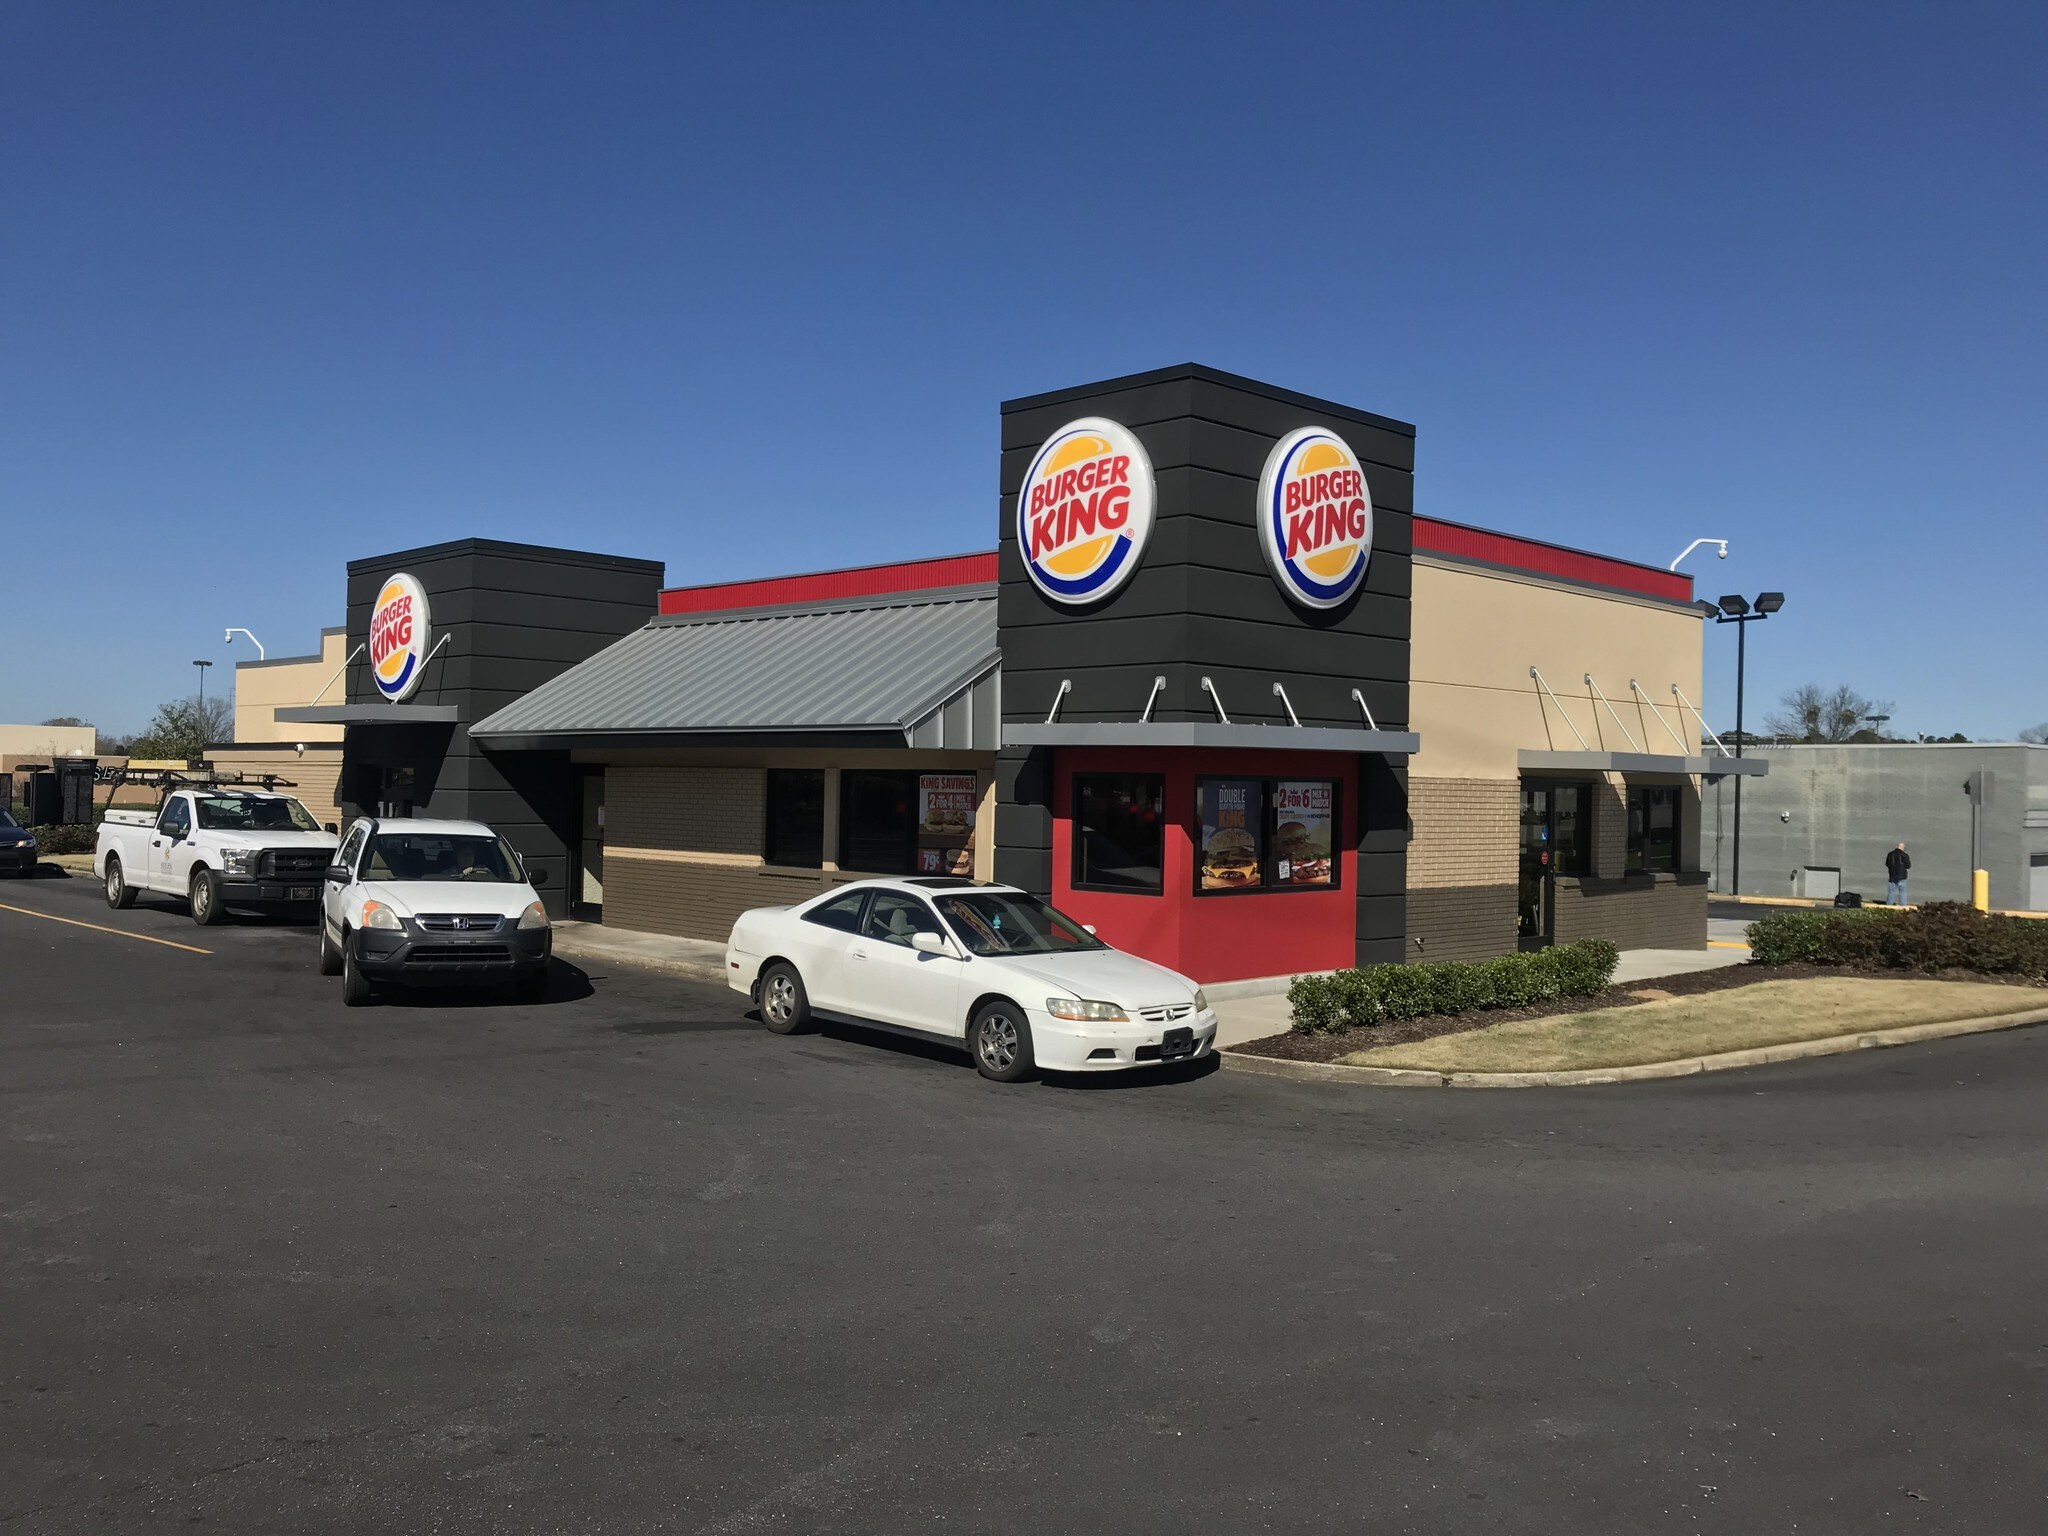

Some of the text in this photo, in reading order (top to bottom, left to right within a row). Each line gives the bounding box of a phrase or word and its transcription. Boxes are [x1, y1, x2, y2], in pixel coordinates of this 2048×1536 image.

[1030, 455, 1130, 518] BURGER
[1286, 470, 1363, 515] BURGER
[1031, 485, 1131, 561] KING
[1287, 498, 1365, 559] KING
[371, 595, 412, 642] BURGER
[371, 615, 412, 670] KING
[929, 793, 936, 809] 2
[1219, 788, 1246, 803] DOUBLE
[1279, 788, 1287, 808] 2
[1287, 795, 1302, 807] FOR
